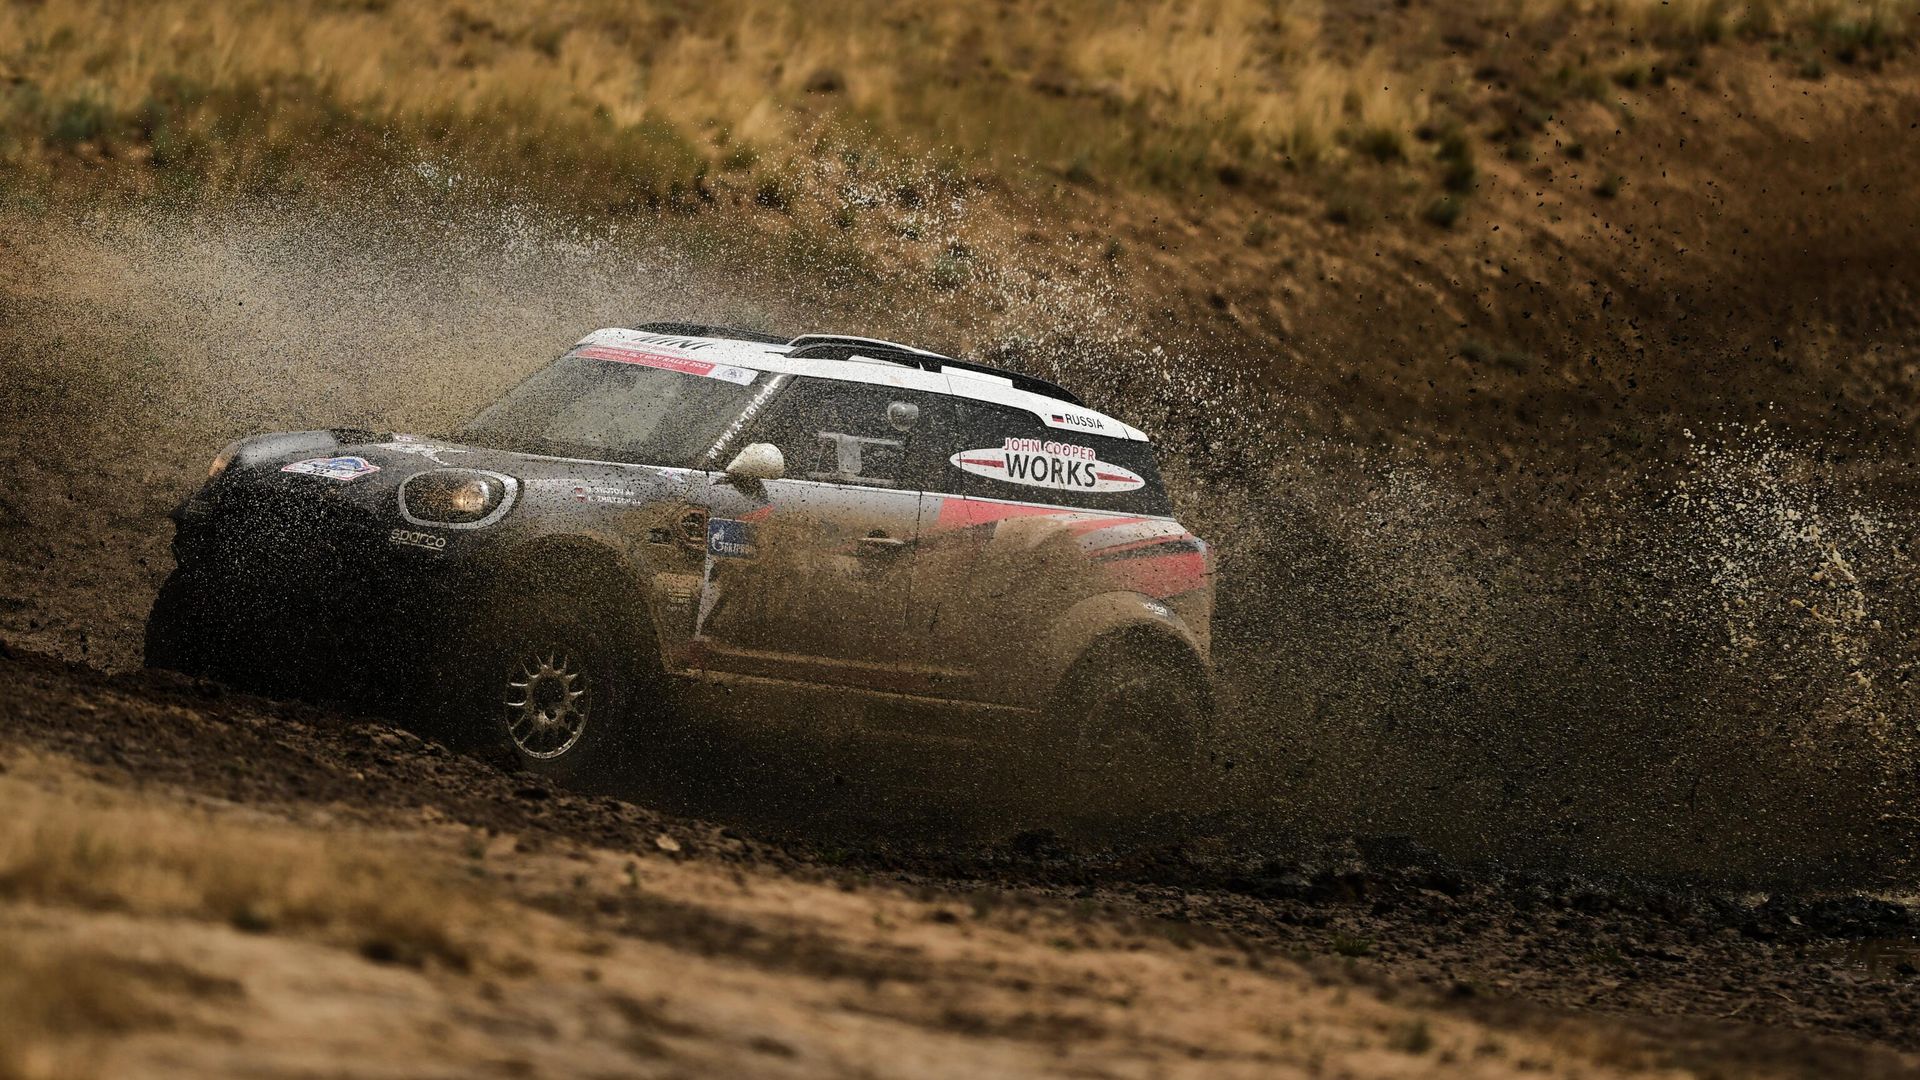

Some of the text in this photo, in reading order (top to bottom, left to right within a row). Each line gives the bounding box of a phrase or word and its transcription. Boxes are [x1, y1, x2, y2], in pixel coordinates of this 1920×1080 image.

[1065, 414, 1103, 429] RUSSIA
[1005, 438, 1095, 461] JOHN COOPER
[1005, 453, 1096, 487] WORKS
[391, 528, 446, 549] sparco
